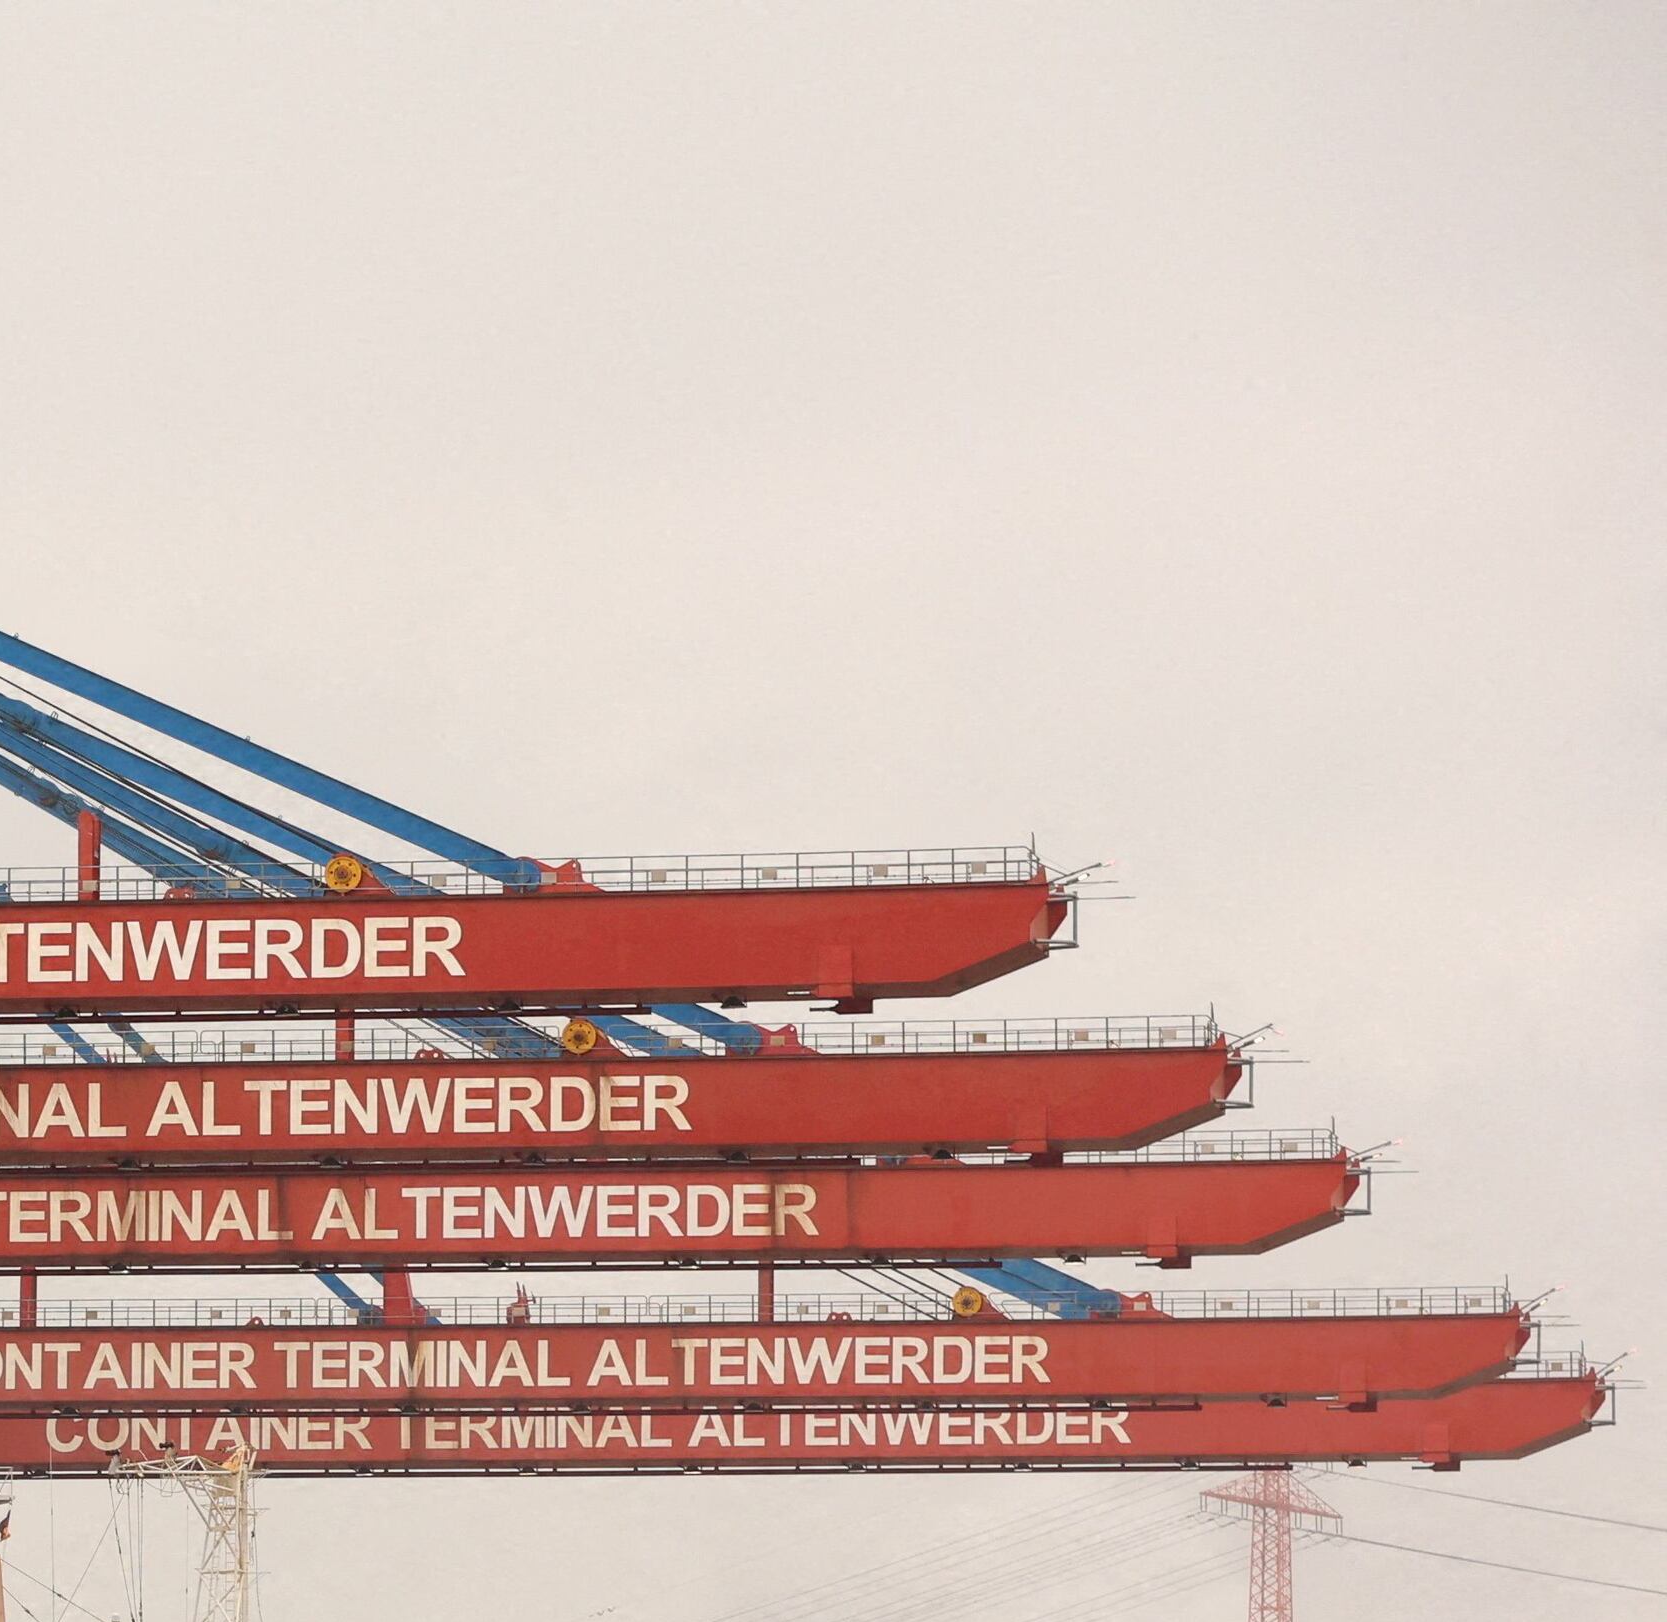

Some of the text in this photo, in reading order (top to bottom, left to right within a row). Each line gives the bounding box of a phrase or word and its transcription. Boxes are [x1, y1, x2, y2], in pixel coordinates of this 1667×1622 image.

[145, 1075, 693, 1137] ALTENWERDER
[310, 1183, 820, 1241] ALTENWERDER
[273, 1339, 571, 1389] TERMINAL
[586, 1335, 1051, 1387] ALTENWERDER
[45, 1404, 1132, 1453] CONTAINER TERMINAL ALTENWERDER
